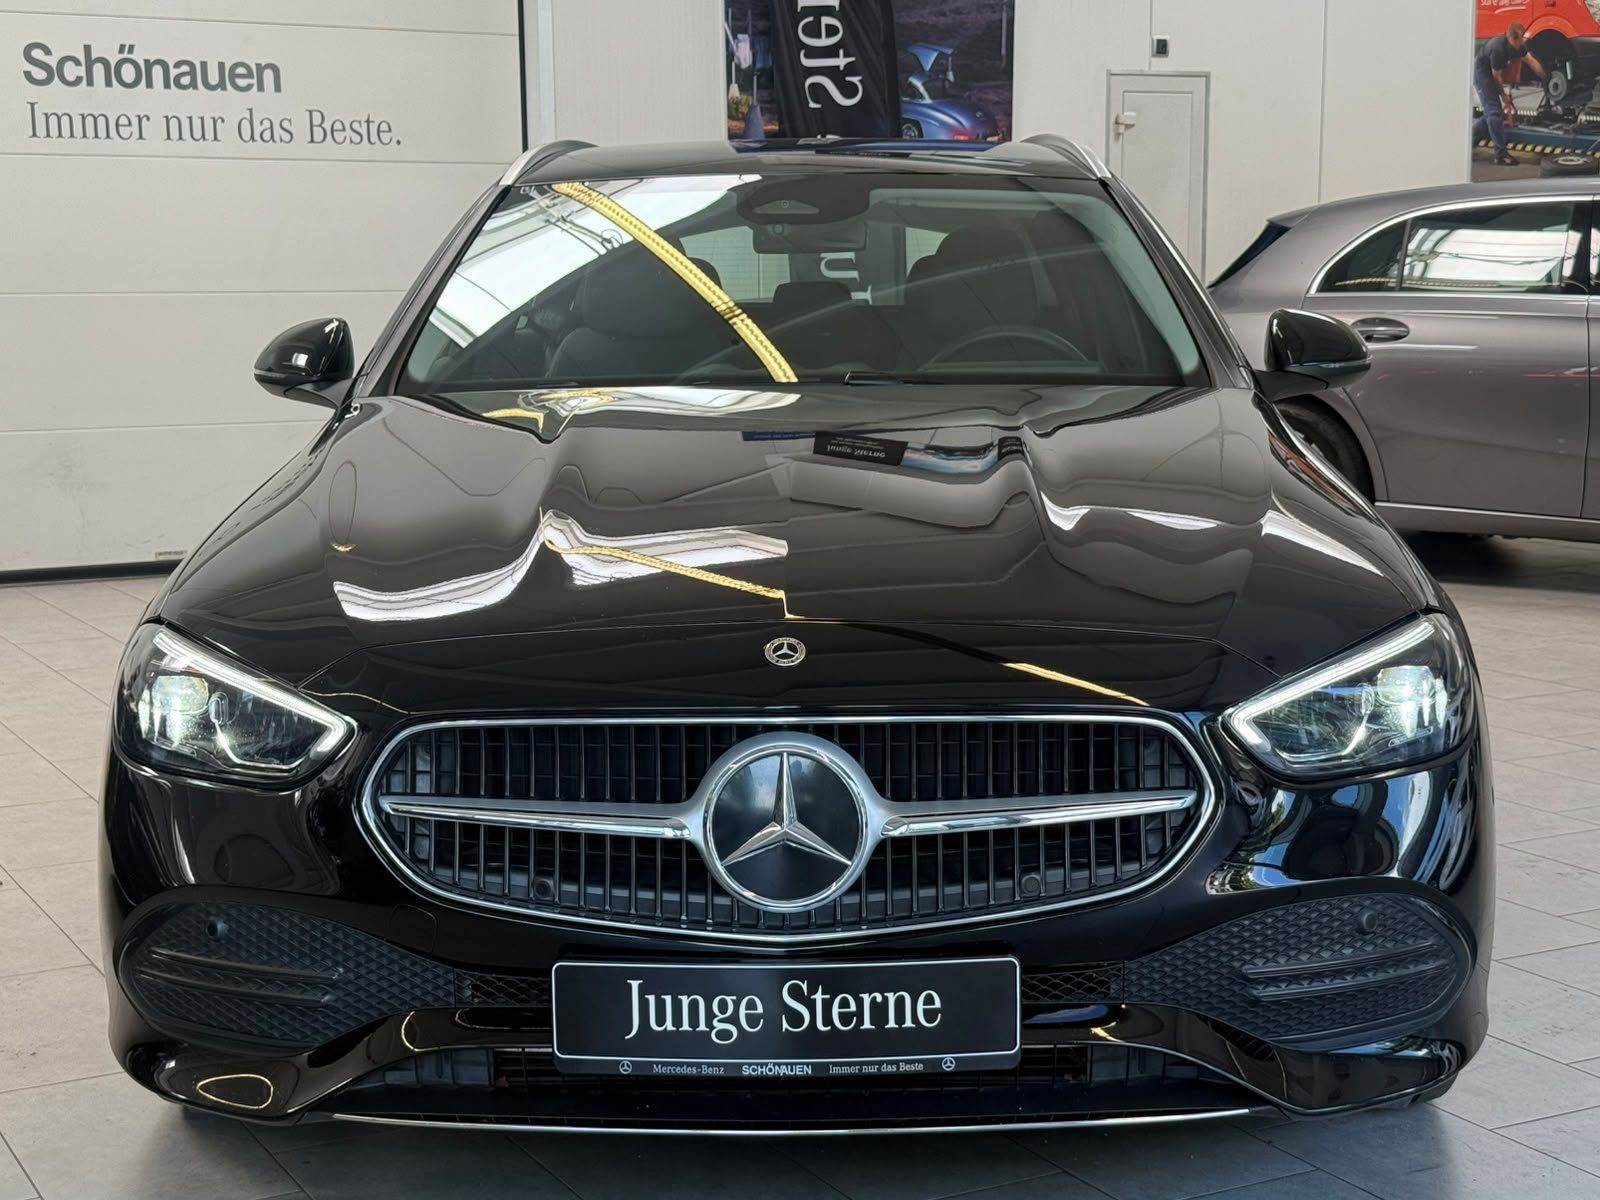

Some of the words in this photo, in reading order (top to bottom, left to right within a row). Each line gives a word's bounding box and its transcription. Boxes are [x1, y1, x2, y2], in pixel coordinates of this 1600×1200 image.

[22, 41, 282, 94] Schönauen
[26, 101, 151, 141] Immer
[163, 115, 226, 142] nur
[237, 107, 294, 144] das
[305, 109, 402, 146] Beste.
[624, 979, 764, 1045] Junge
[781, 979, 942, 1033] Sterne
[652, 1063, 725, 1076] Mercedes-Benz
[741, 1063, 812, 1077] SCHÖNAUEN
[828, 1063, 860, 1074] Immer
[862, 1064, 879, 1074] nur
[880, 1061, 897, 1073] das
[899, 1060, 924, 1073] Beste
